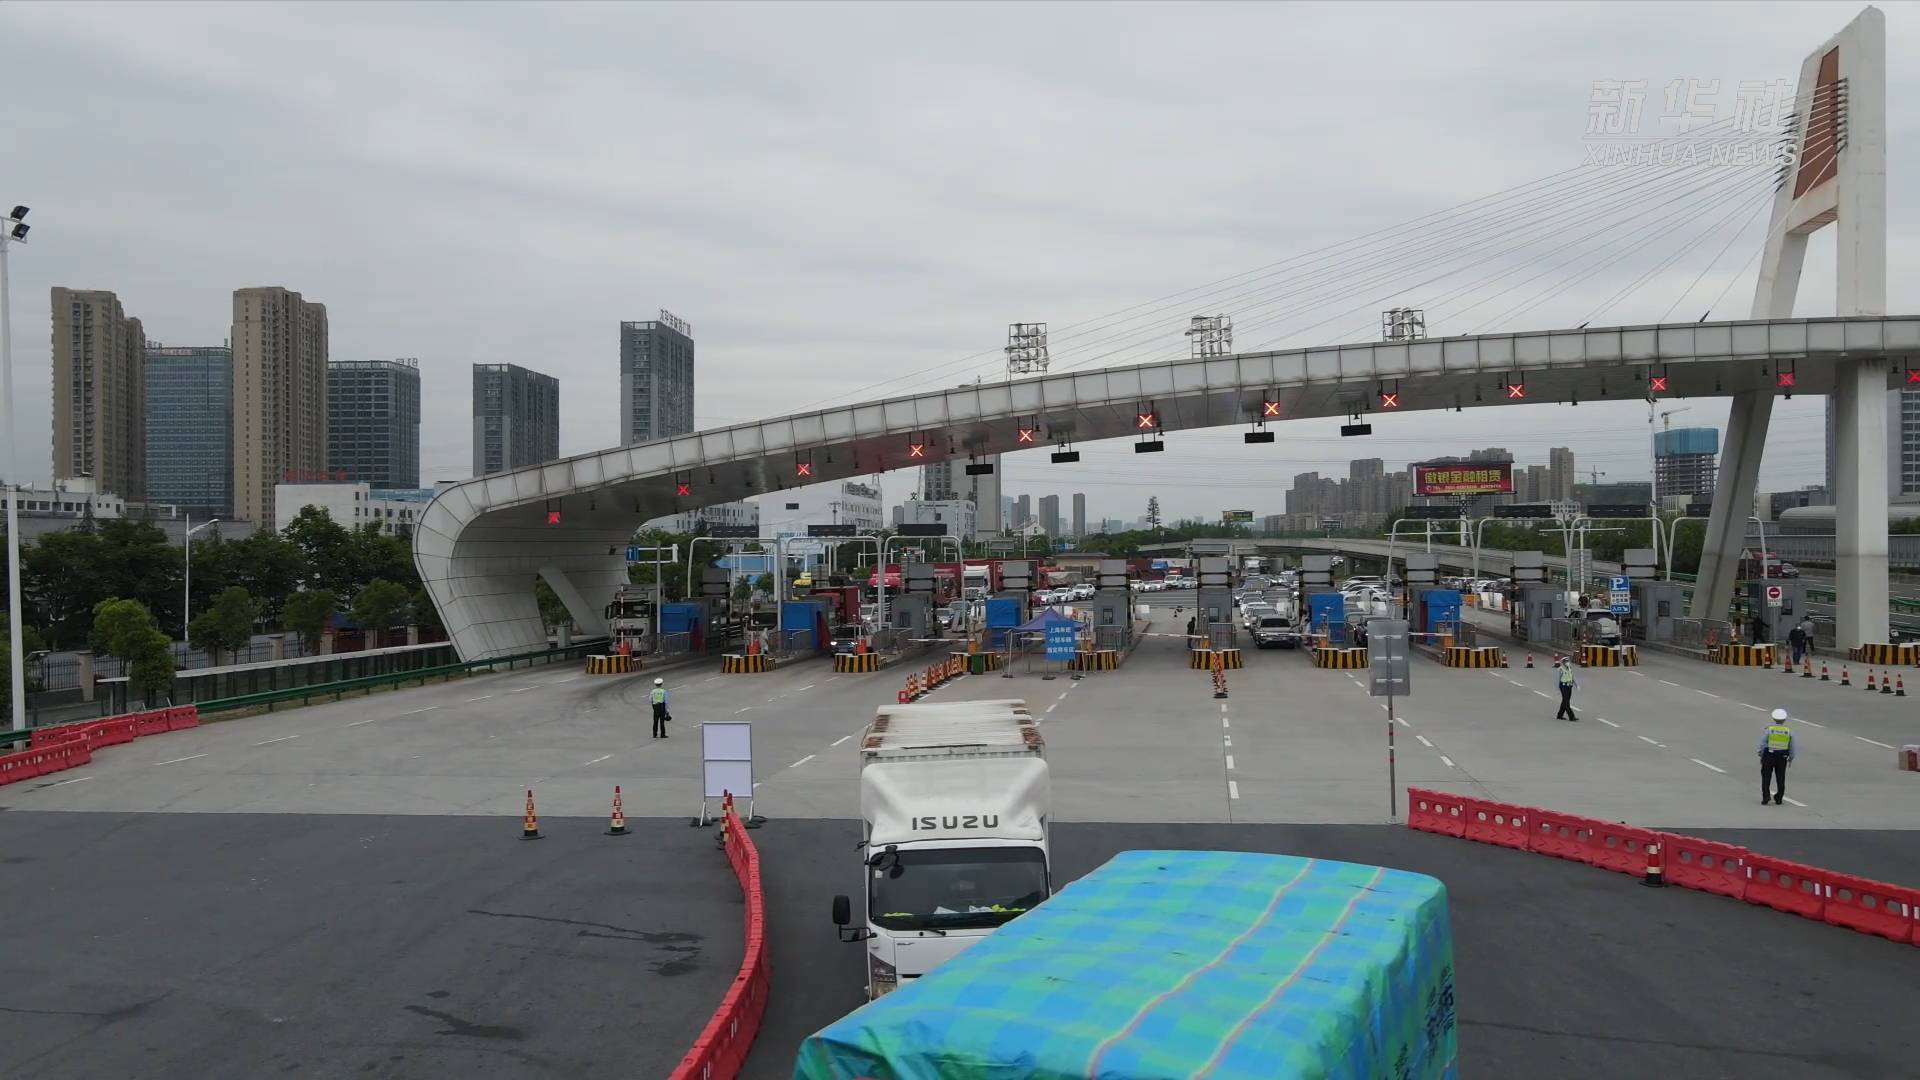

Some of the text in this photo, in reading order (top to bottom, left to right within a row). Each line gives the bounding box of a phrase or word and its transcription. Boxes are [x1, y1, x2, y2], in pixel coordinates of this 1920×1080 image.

[1425, 470, 1501, 483] 徽银金融租赁
[1612, 577, 1624, 590] P
[912, 814, 999, 831] ISUZU
